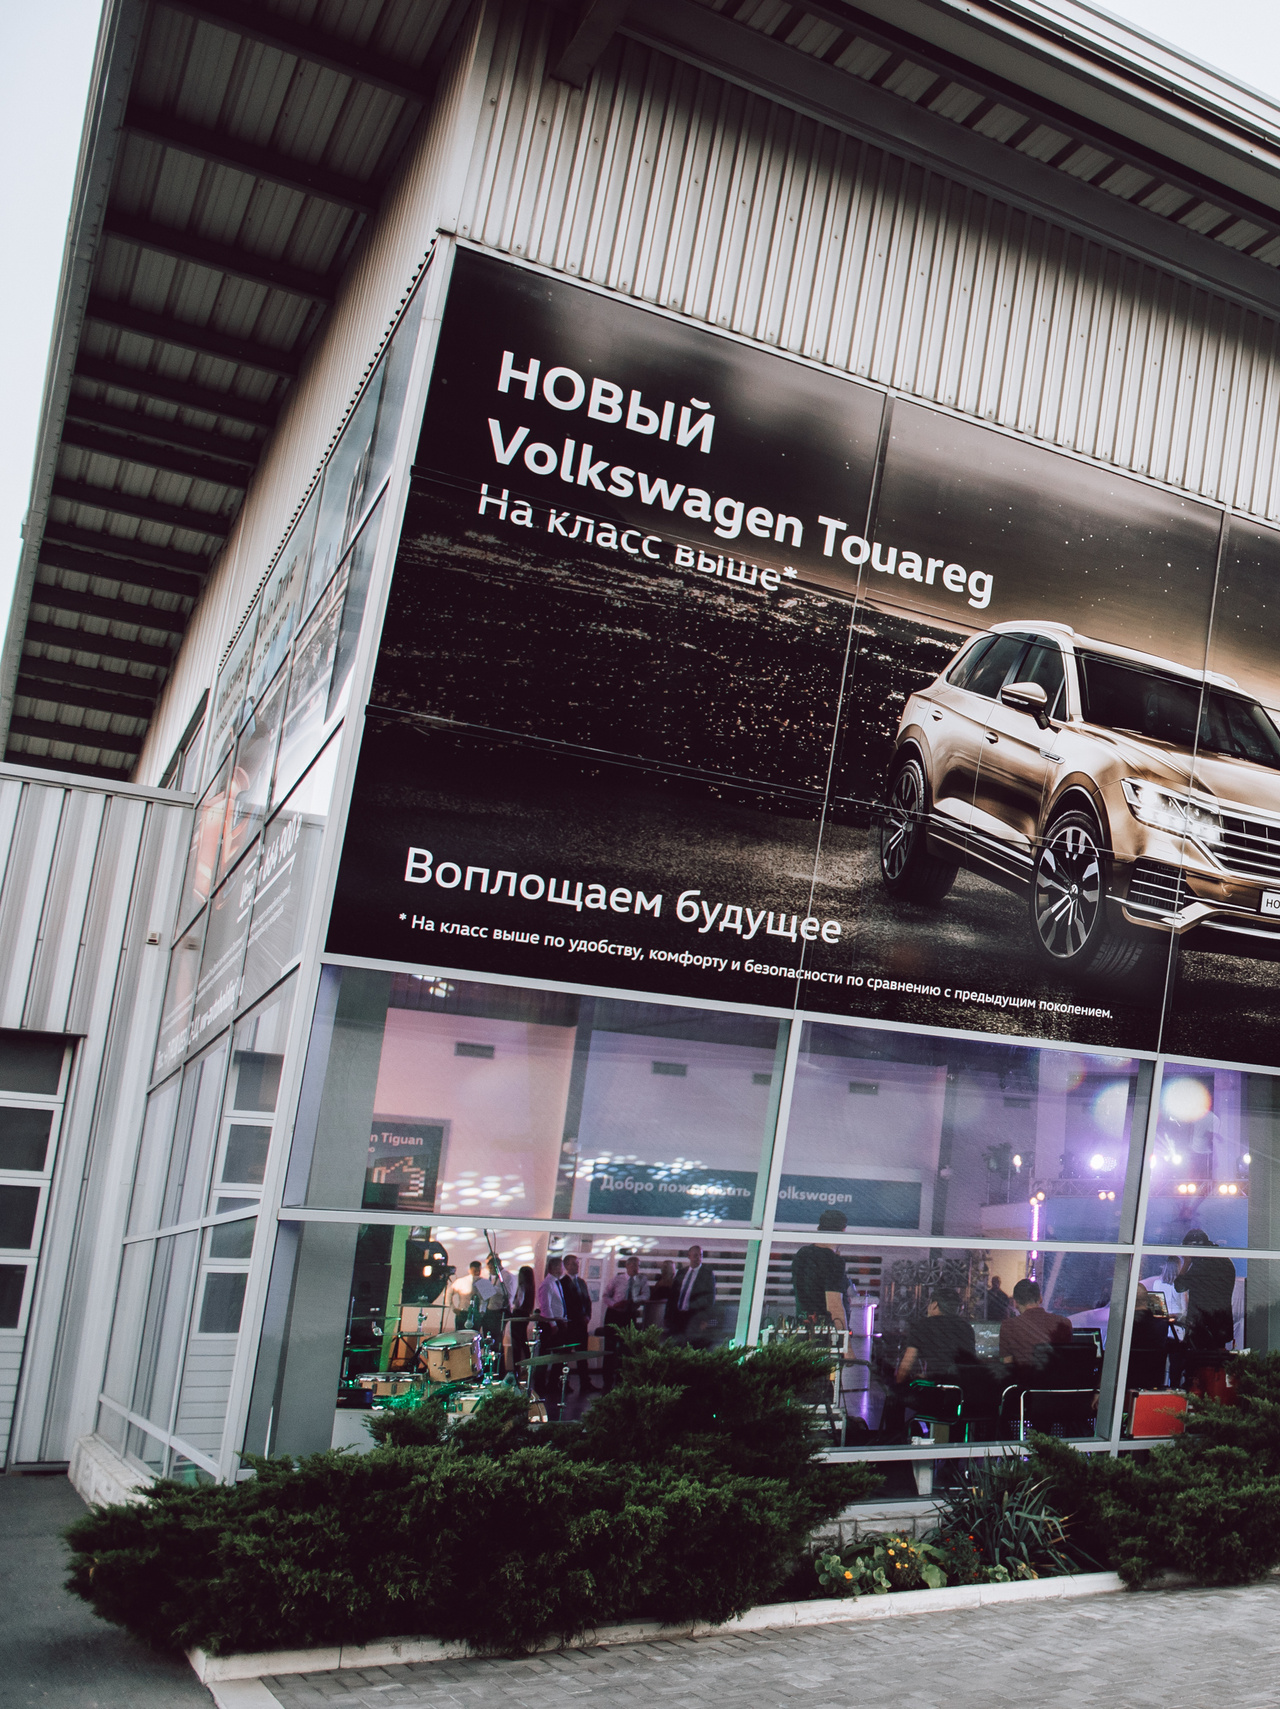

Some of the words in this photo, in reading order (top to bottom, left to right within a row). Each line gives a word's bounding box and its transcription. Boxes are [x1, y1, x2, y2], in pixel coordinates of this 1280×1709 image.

[497, 350, 716, 453] НОВЫЙ
[477, 484, 534, 529] На
[547, 508, 662, 560] класс
[487, 418, 804, 548] Volkswagen
[818, 515, 994, 608] Touareg
[404, 846, 663, 919] Воплощаем
[675, 889, 842, 945] будущее
[411, 914, 435, 931] На
[440, 919, 488, 939] класс
[493, 927, 539, 945] выше
[544, 933, 565, 947] по
[568, 936, 645, 962] удобству,
[648, 947, 728, 972] комфорту
[731, 959, 741, 971] и
[744, 959, 843, 984] безопасности
[847, 974, 864, 986] по
[867, 975, 941, 998] сравнению
[944, 987, 952, 998] с
[954, 988, 1036, 1010] предыдущим
[1039, 998, 1114, 1019] поколением.
[381, 1132, 424, 1147] Tiguan
[600, 1175, 654, 1193] Добро
[658, 1181, 751, 1198] пожать
[778, 1186, 853, 1205] olkswagen
